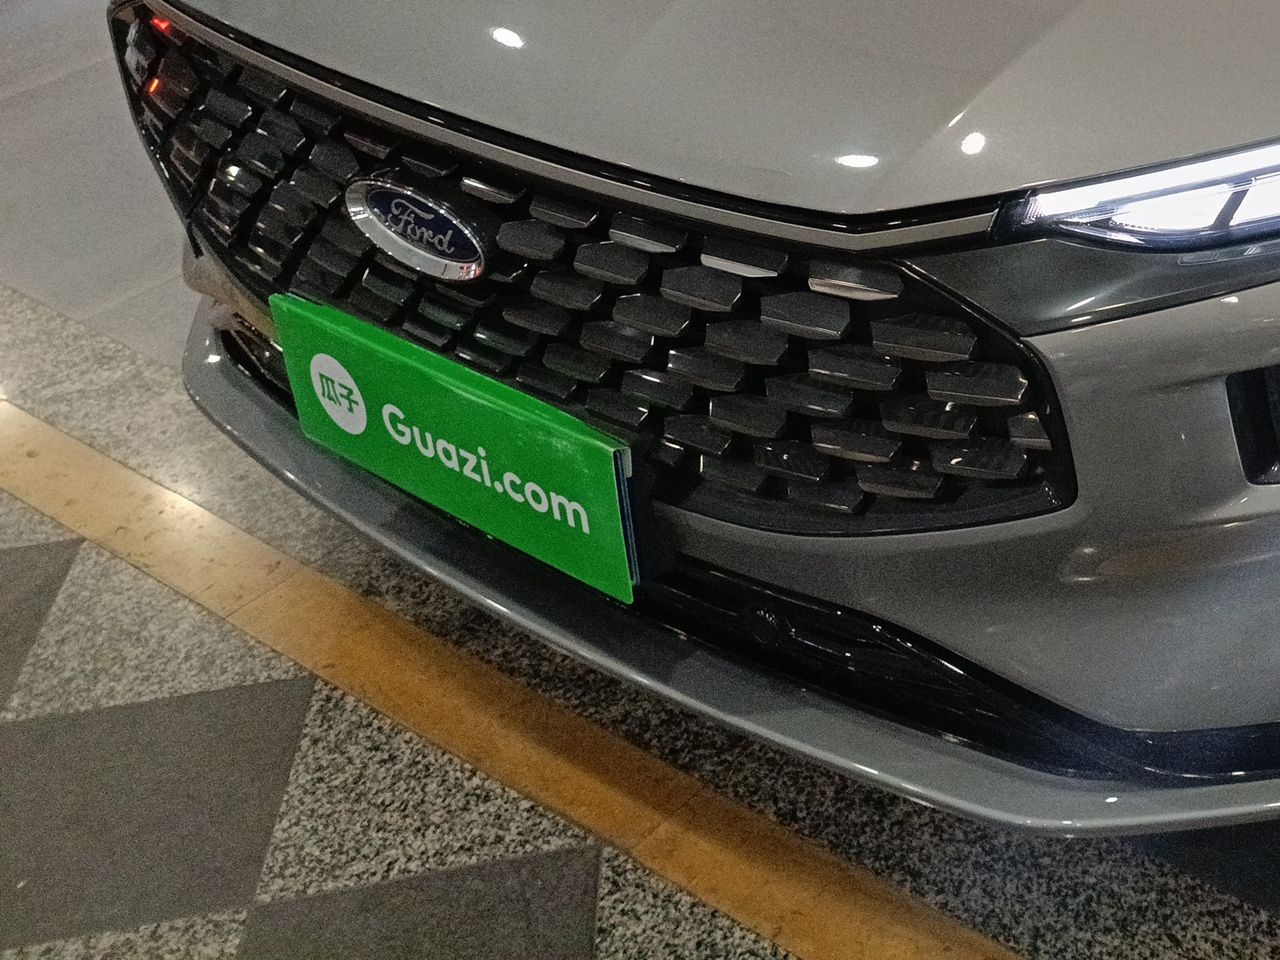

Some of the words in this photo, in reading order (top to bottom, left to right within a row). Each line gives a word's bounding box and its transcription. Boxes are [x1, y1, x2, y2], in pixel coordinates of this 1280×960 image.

[388, 199, 454, 253] Ford
[318, 372, 360, 413] 瓜子
[382, 403, 590, 535] Guazi.com
